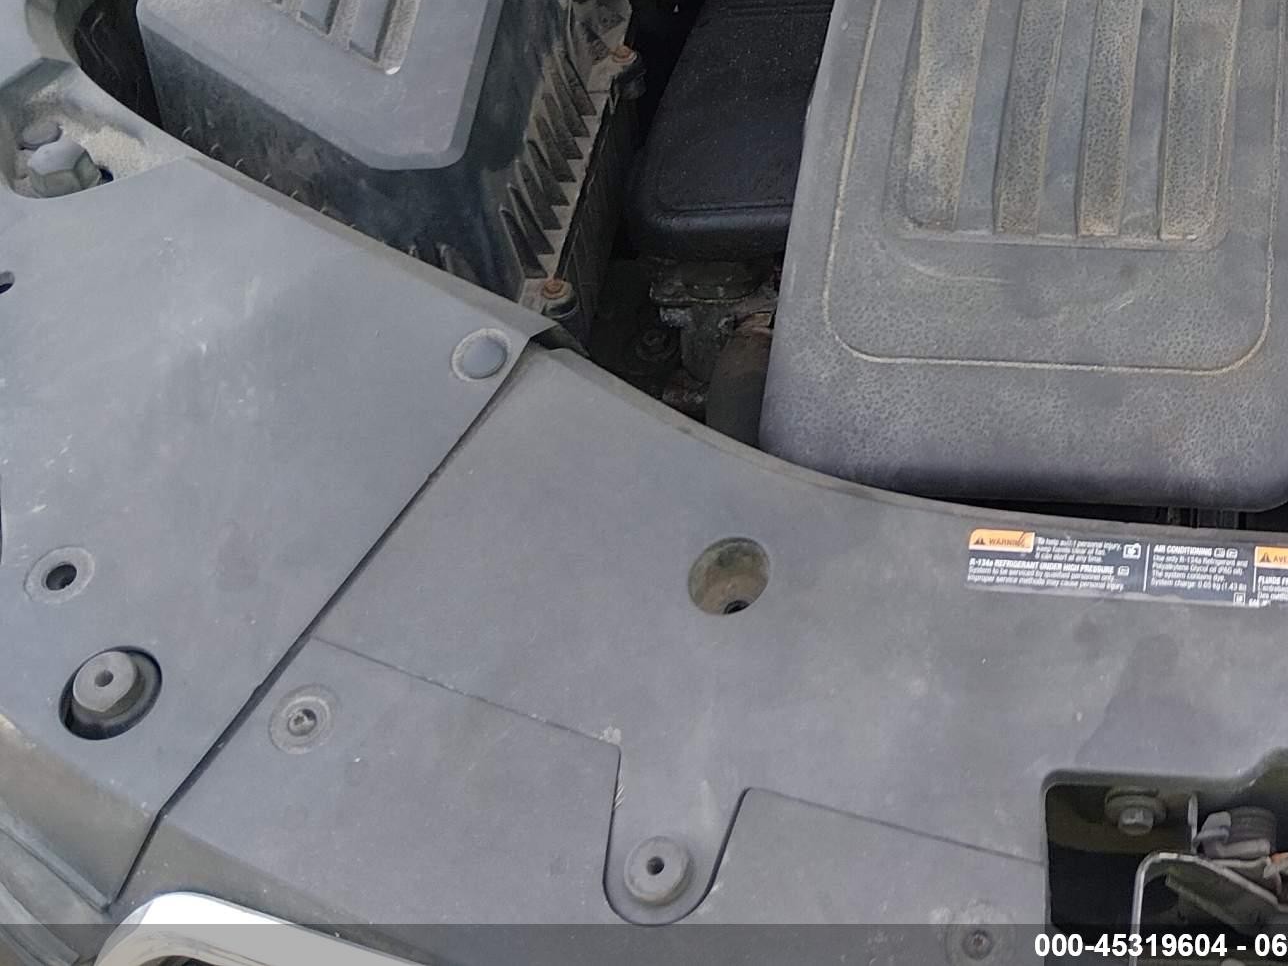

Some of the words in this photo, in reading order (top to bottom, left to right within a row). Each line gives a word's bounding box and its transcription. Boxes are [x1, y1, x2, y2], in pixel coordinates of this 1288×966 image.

[1153, 545, 1166, 554] AIR
[1166, 546, 1213, 557] CONDITIONING
[994, 560, 1039, 570] REFRIGERANT
[1039, 563, 1063, 572] UNDER
[1080, 566, 1115, 575] PRESSURE
